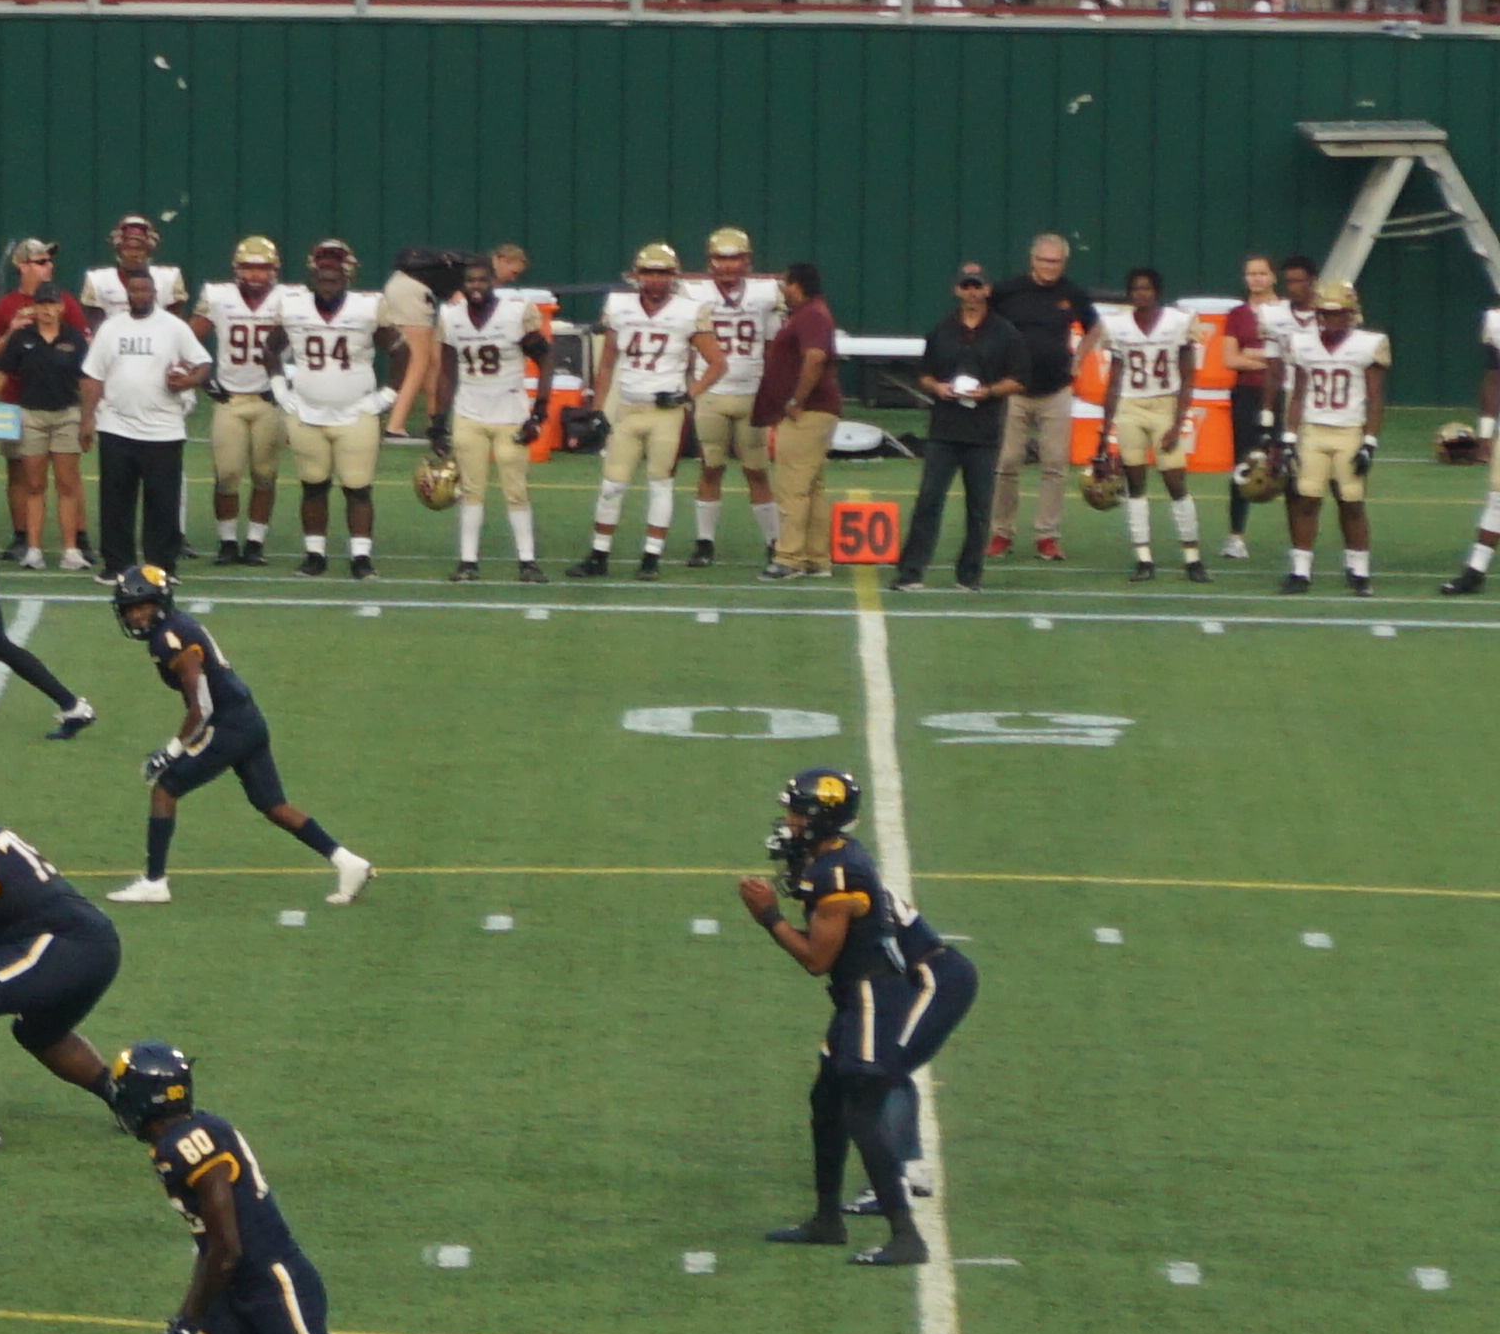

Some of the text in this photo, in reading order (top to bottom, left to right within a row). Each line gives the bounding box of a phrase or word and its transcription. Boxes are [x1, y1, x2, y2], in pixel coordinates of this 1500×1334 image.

[118, 336, 154, 356] BALL
[229, 324, 268, 365] 95
[626, 331, 668, 371] 47
[1126, 349, 1171, 391] 84
[838, 511, 894, 555] 50
[176, 1127, 216, 1166] 80
